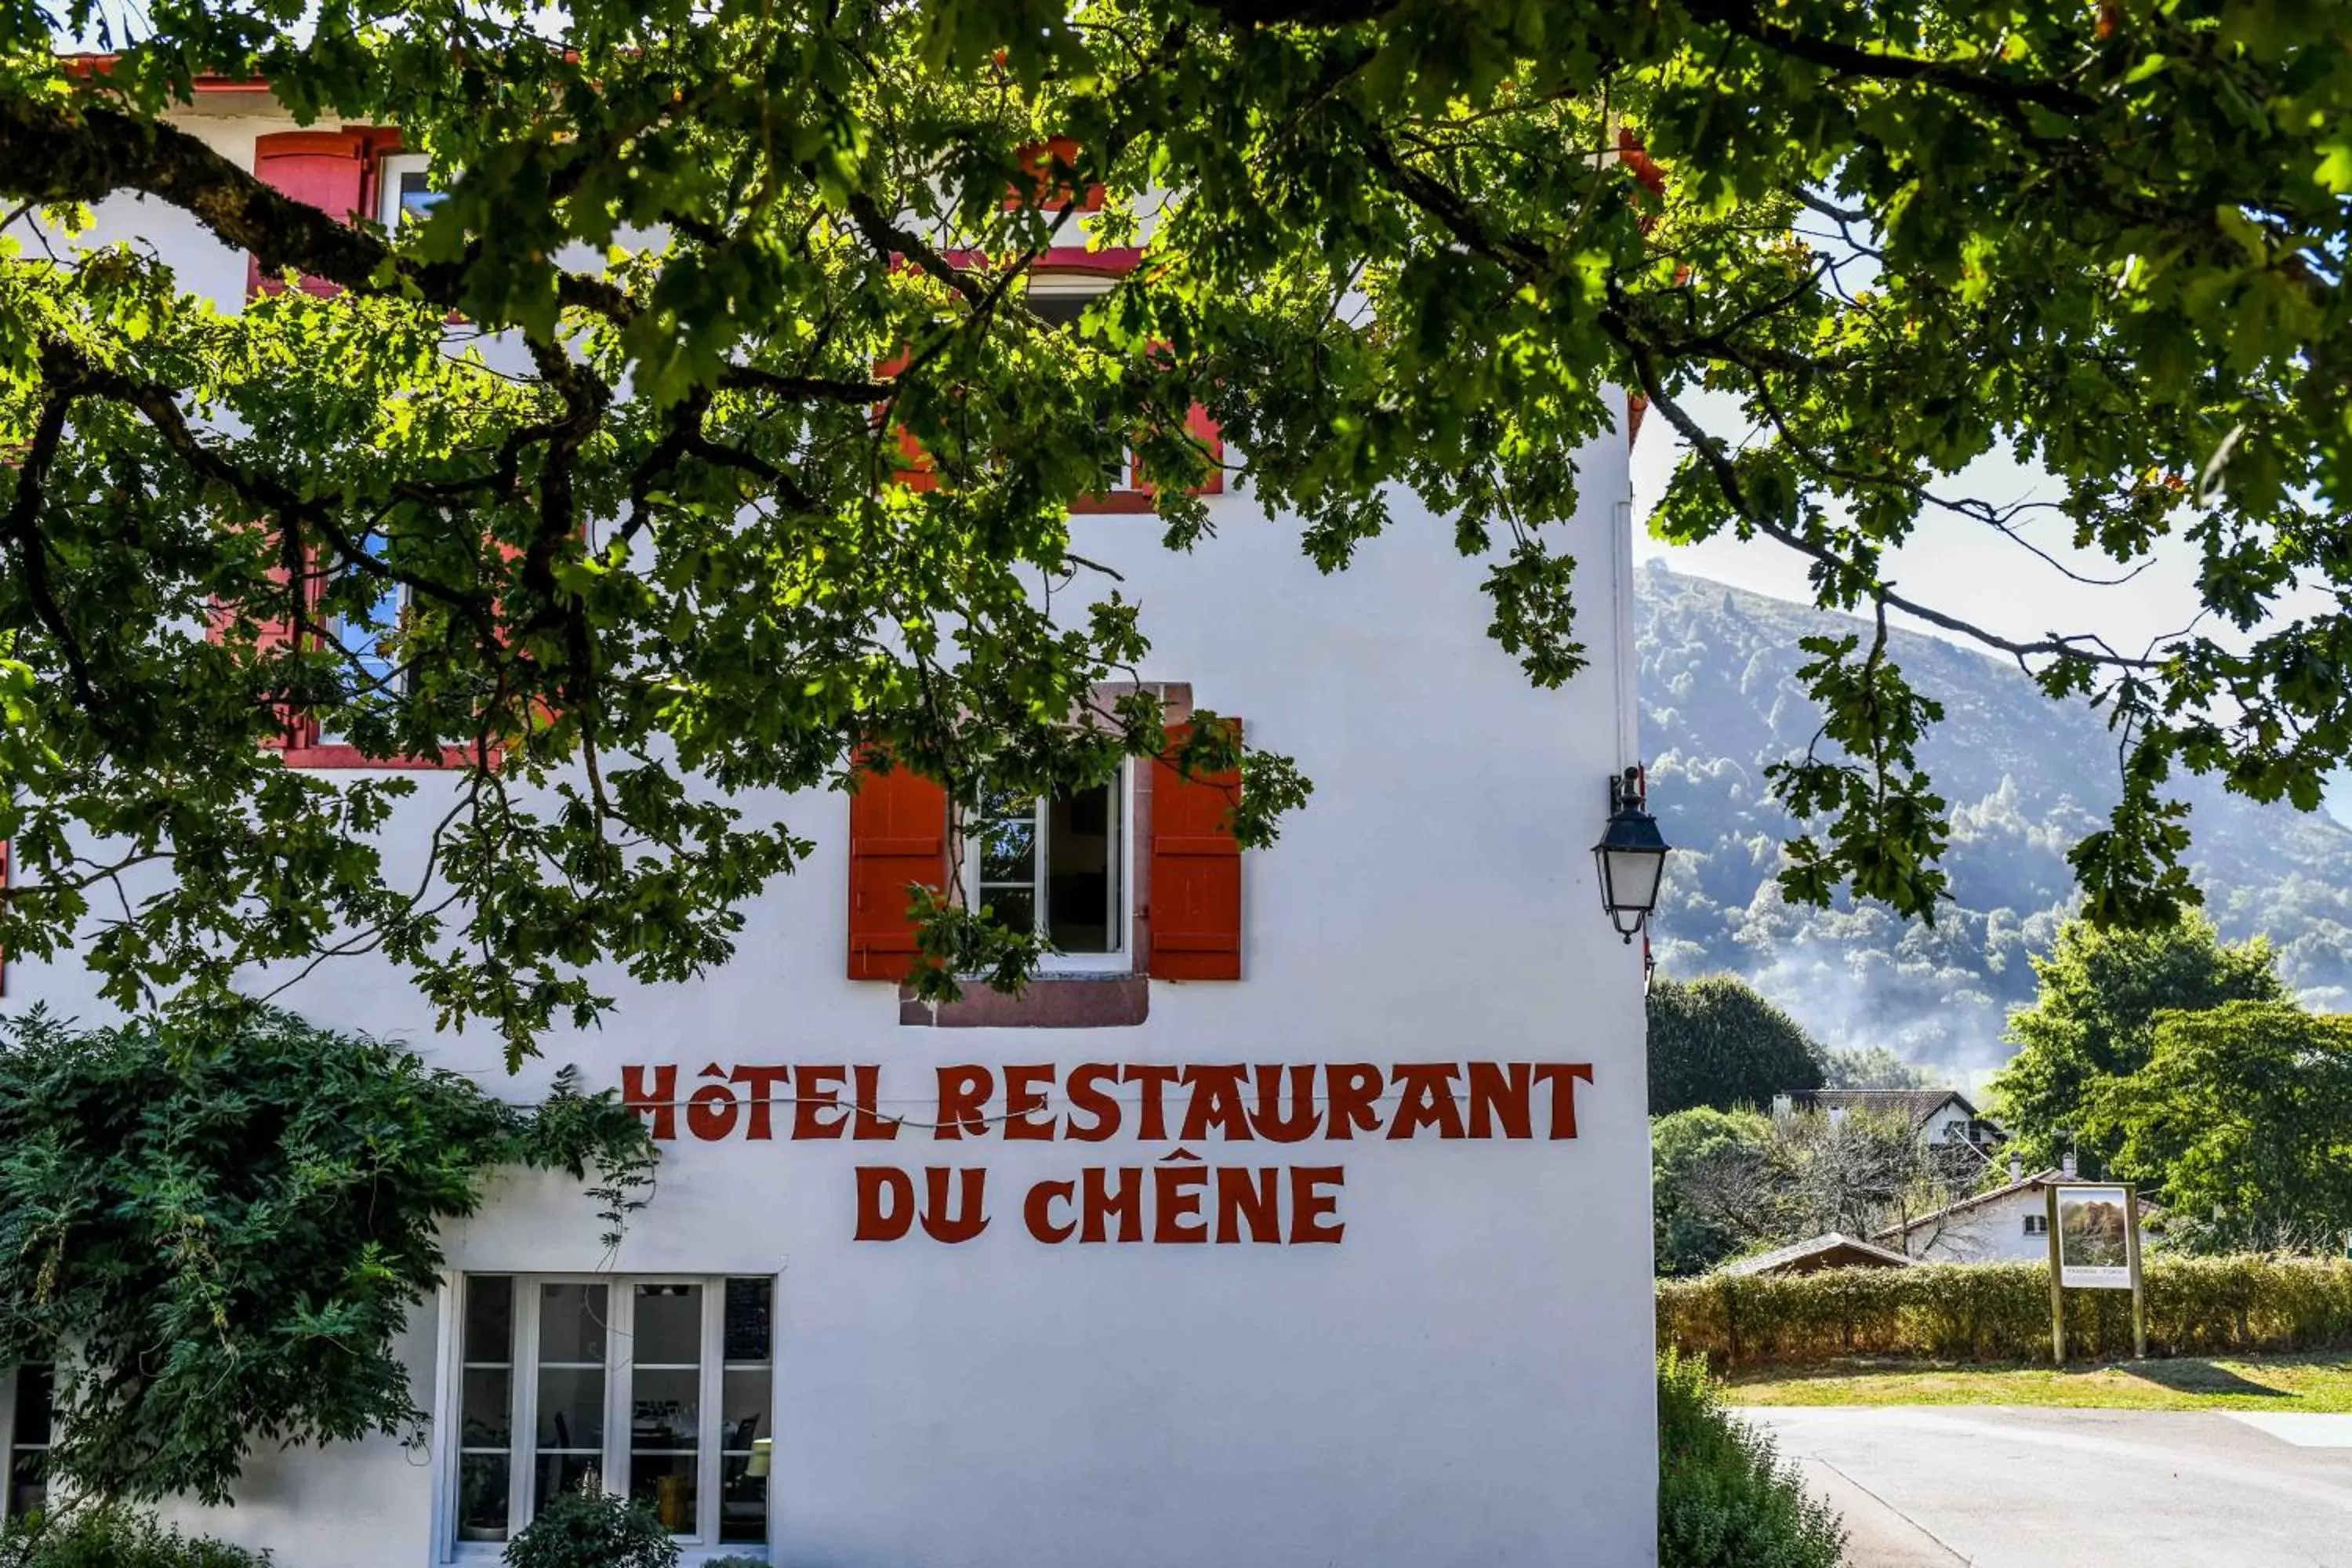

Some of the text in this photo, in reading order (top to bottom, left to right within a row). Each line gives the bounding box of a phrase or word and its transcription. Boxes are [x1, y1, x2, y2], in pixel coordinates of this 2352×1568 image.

[935, 1062, 1593, 1142] RESTAURANT
[855, 1148, 1345, 1244] DU CHÊNE
